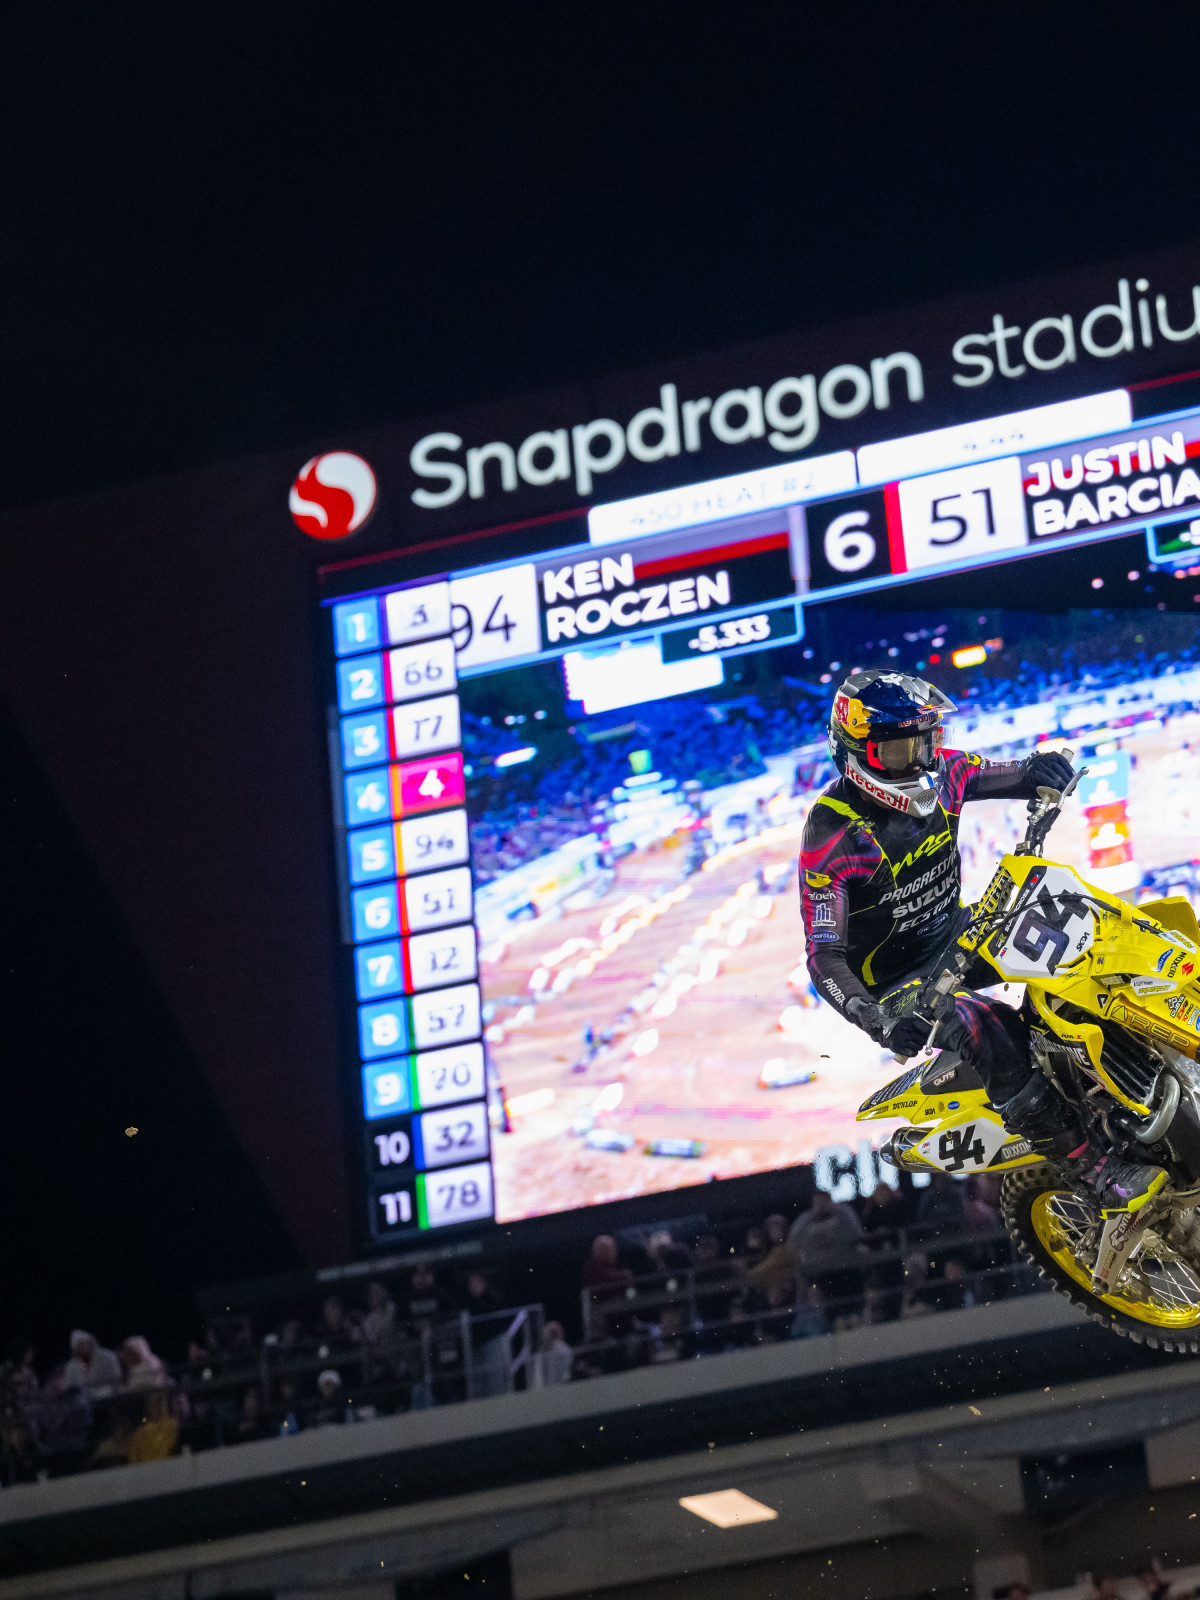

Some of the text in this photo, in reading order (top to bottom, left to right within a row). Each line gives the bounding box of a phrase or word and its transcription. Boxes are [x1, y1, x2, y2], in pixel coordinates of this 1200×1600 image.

[410, 350, 925, 509] Snapdragon
[1026, 431, 1188, 498] JUSTIN
[630, 500, 683, 527] 450
[692, 481, 769, 516] HEAT
[929, 488, 997, 547] 51
[823, 510, 877, 572] 6
[542, 553, 636, 602] KEN
[349, 612, 367, 643] 1
[451, 595, 517, 652] 94
[547, 570, 731, 643] ROCZEN
[689, 614, 770, 652] -5.333
[348, 655, 443, 700] 2 66
[351, 712, 445, 757] 3 77
[357, 768, 445, 813] 4 4
[876, 789, 910, 812] Bull
[361, 834, 455, 872] 5 94
[364, 887, 455, 930] 6 51
[892, 865, 958, 919] SUZUKI
[898, 886, 958, 933] ECSTAR
[1012, 883, 1091, 977] 94
[367, 946, 460, 986] 7 12
[1166, 951, 1188, 979] DIXXON
[371, 1004, 466, 1046] 8 57
[1170, 994, 1187, 1018] DUBYA
[1131, 1014, 1191, 1048] REP
[375, 1062, 472, 1106] 9 70
[933, 1070, 955, 1086] GUTS
[892, 1100, 918, 1110] DUNLOP
[374, 1120, 475, 1166] 10 32
[938, 1124, 986, 1172] 94
[379, 1179, 481, 1225] 11 78
